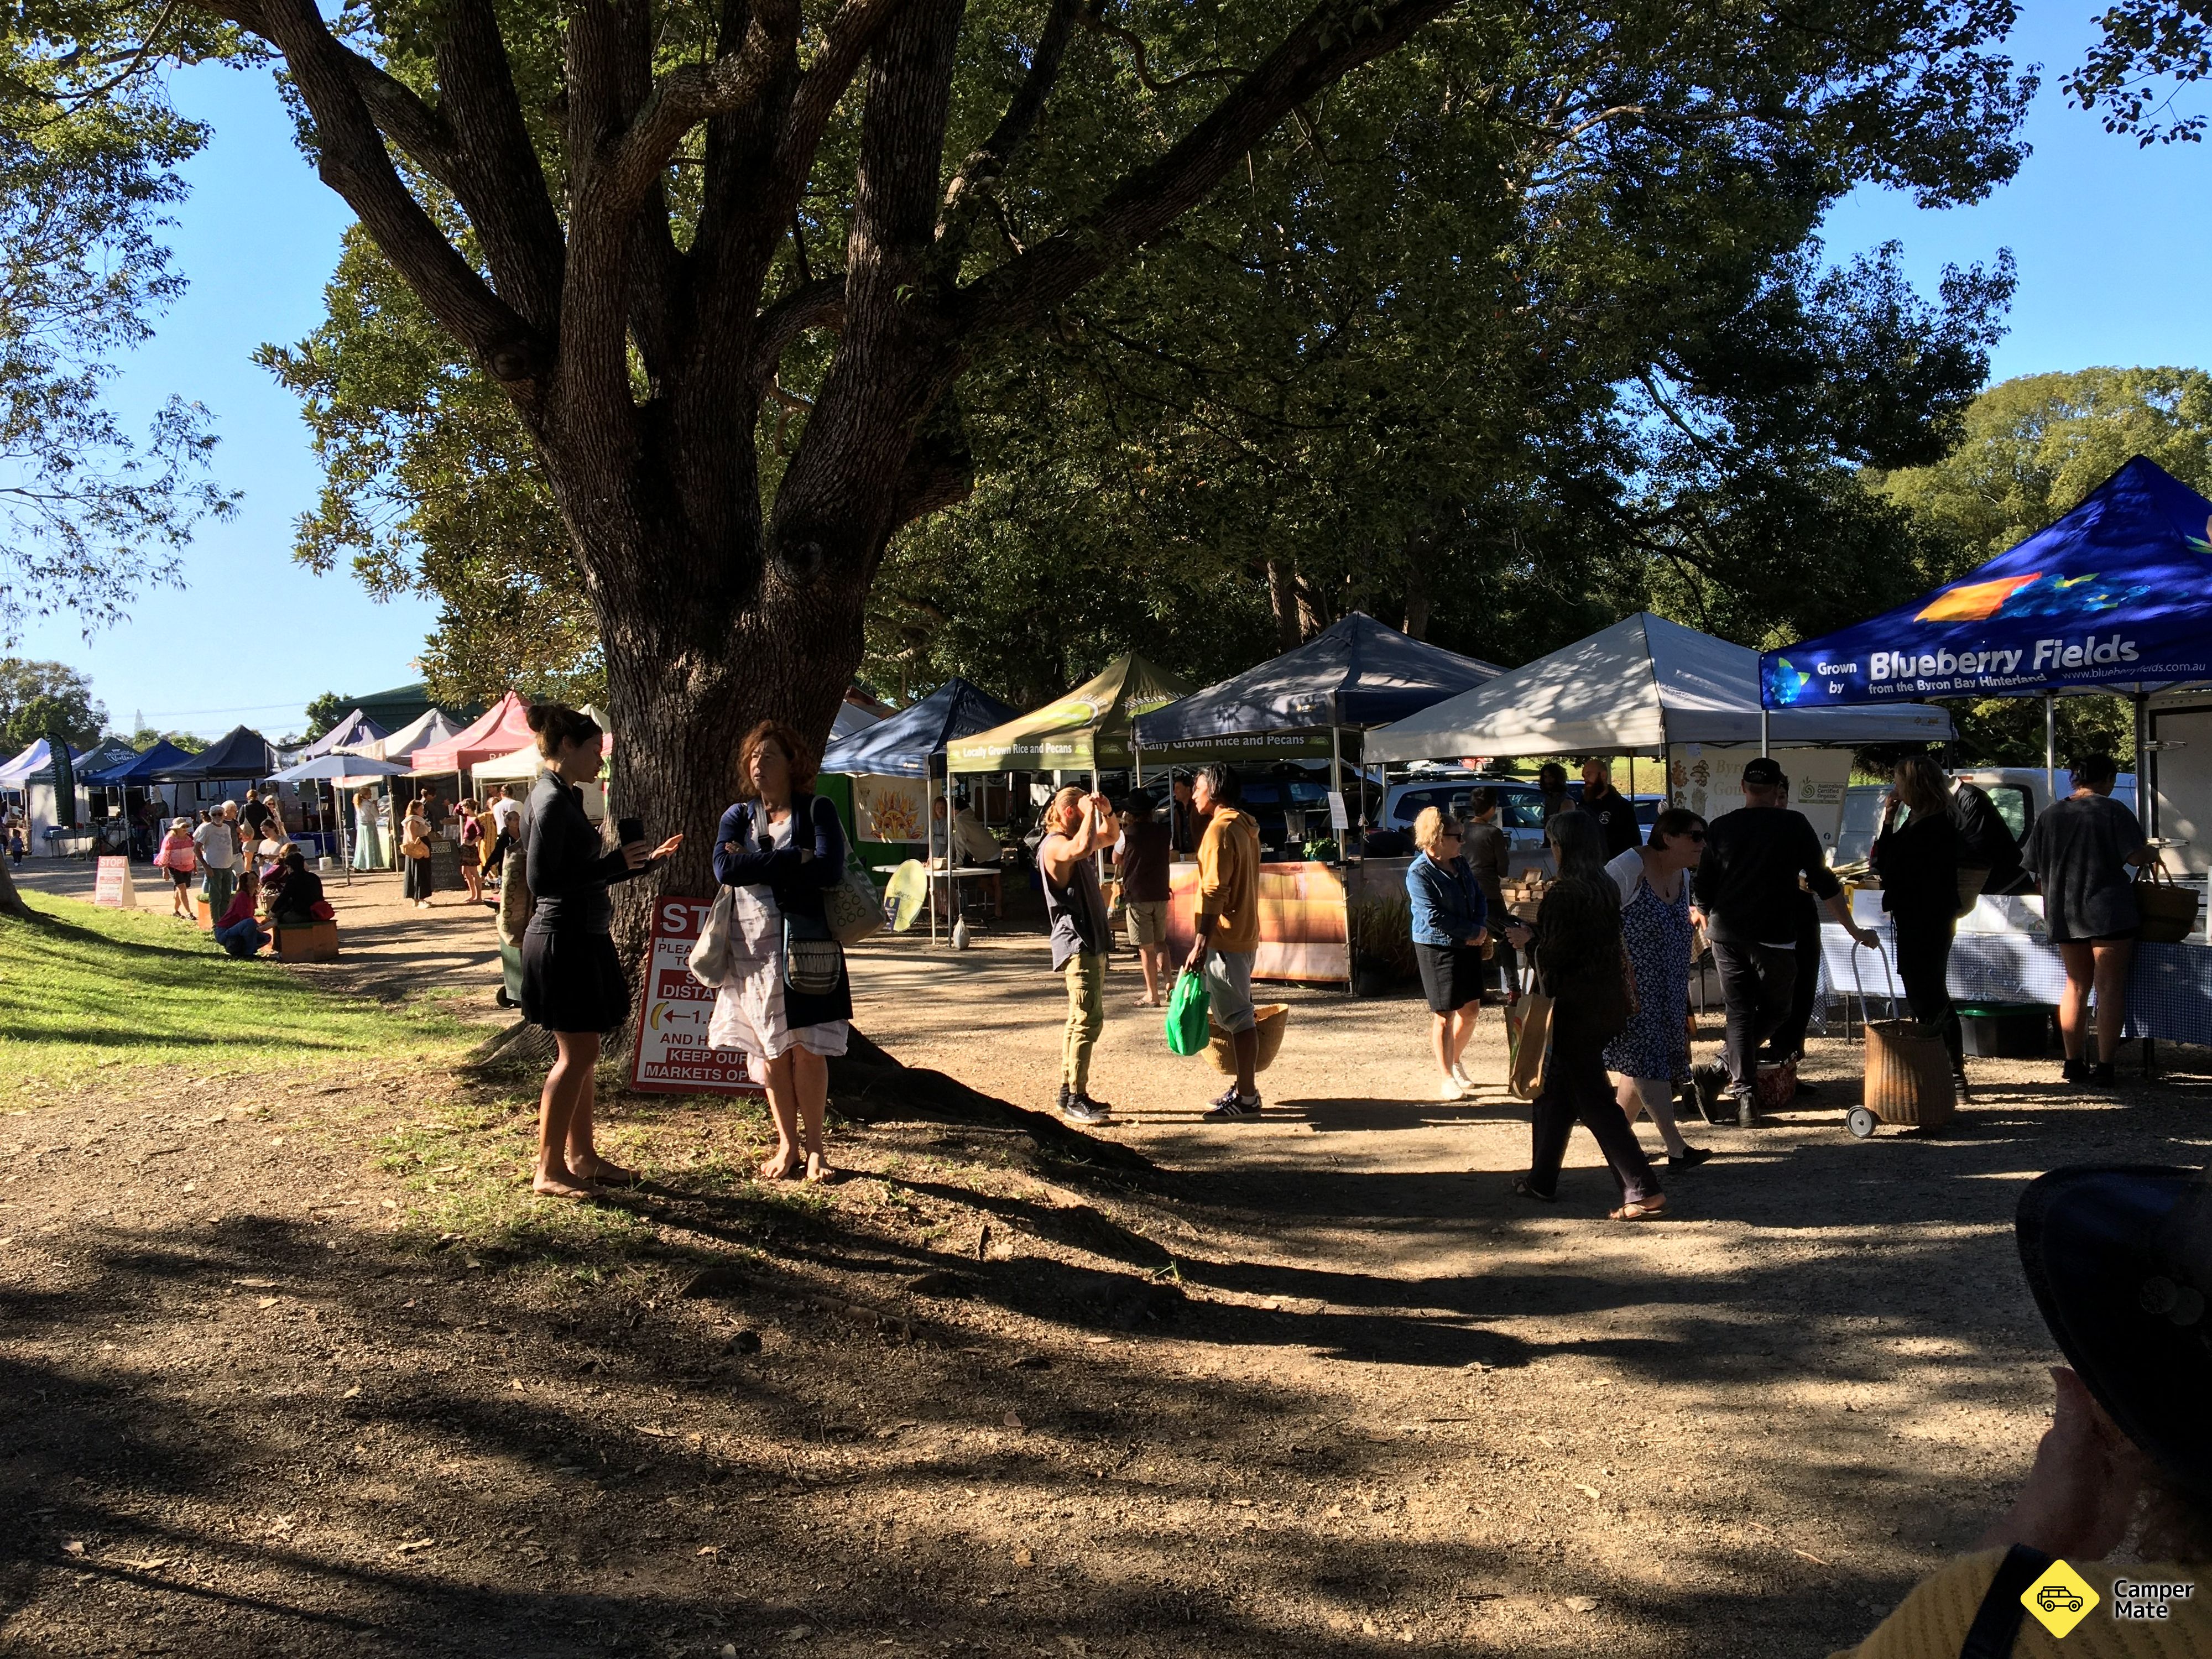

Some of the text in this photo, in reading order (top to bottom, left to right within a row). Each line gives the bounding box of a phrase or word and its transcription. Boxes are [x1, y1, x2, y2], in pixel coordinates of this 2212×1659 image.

[1870, 634, 2139, 680] Blueberry Fields
[1817, 662, 1857, 675] Grown
[1829, 681, 1844, 695] by
[1869, 673, 2047, 694] from the Byron Bay Hinterland
[1120, 695, 1167, 709] NIMBIN
[1243, 735, 1264, 745] and
[1267, 735, 1304, 745] Pecans
[963, 743, 1072, 759] Locally Grown Rice and Pecans
[1716, 760, 1747, 778] Byro
[1714, 781, 1746, 795] Gou
[100, 858, 125, 867] STOP!
[662, 903, 712, 933] ST
[658, 943, 692, 954] PLEA
[685, 972, 696, 984] S
[663, 984, 721, 999] DISTA
[692, 1010, 713, 1024] 1.
[660, 1033, 708, 1046] AND H
[670, 1050, 712, 1062] KEEP
[646, 1065, 748, 1081] MARKETS OP
